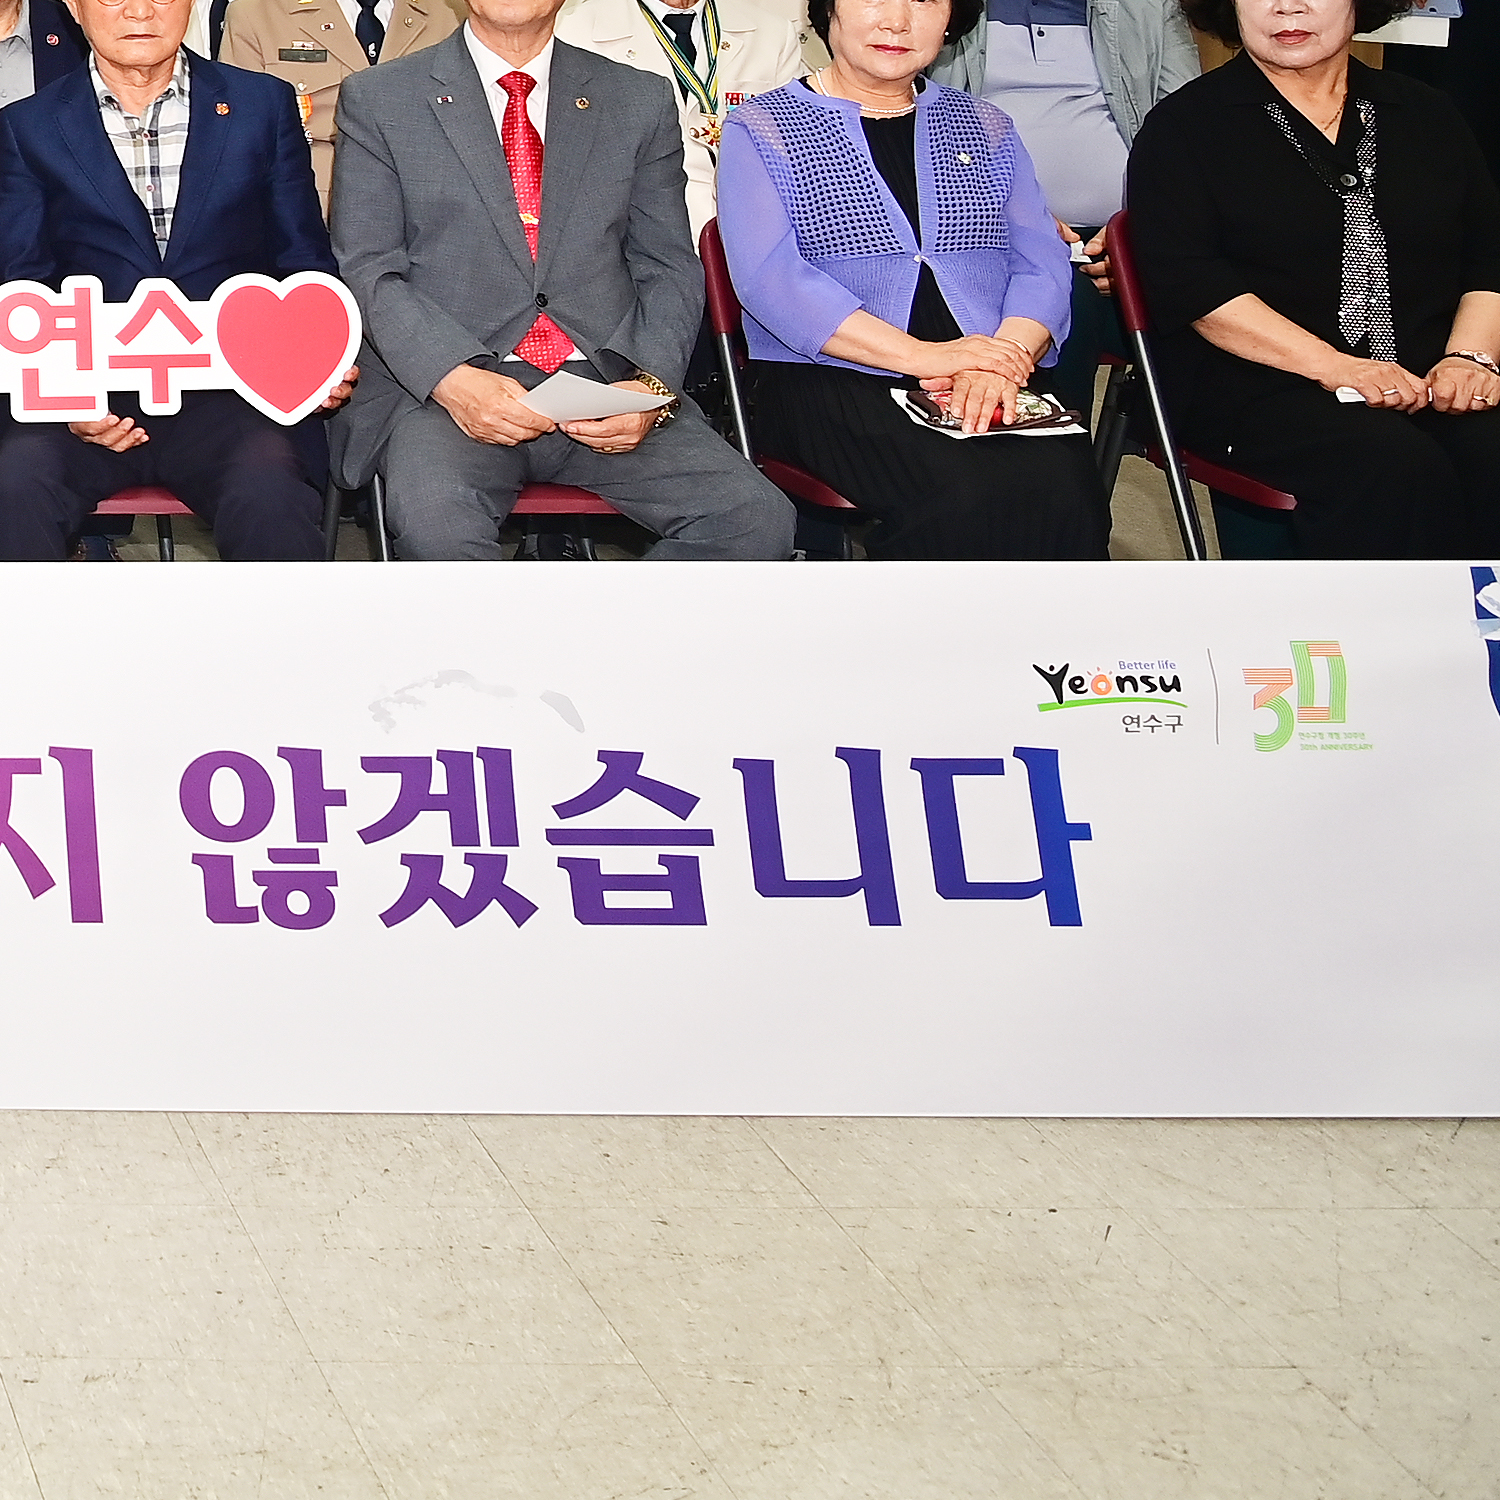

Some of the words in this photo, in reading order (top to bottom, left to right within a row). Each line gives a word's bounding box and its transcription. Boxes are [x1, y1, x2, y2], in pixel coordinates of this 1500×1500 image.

[1032, 662, 1182, 705] Yeonsu
[1118, 660, 1155, 670] Better
[1157, 659, 1176, 670] life
[1241, 640, 1348, 753] 30
[1121, 714, 1184, 734] 연수구
[178, 745, 1093, 931] 않겠습니다
